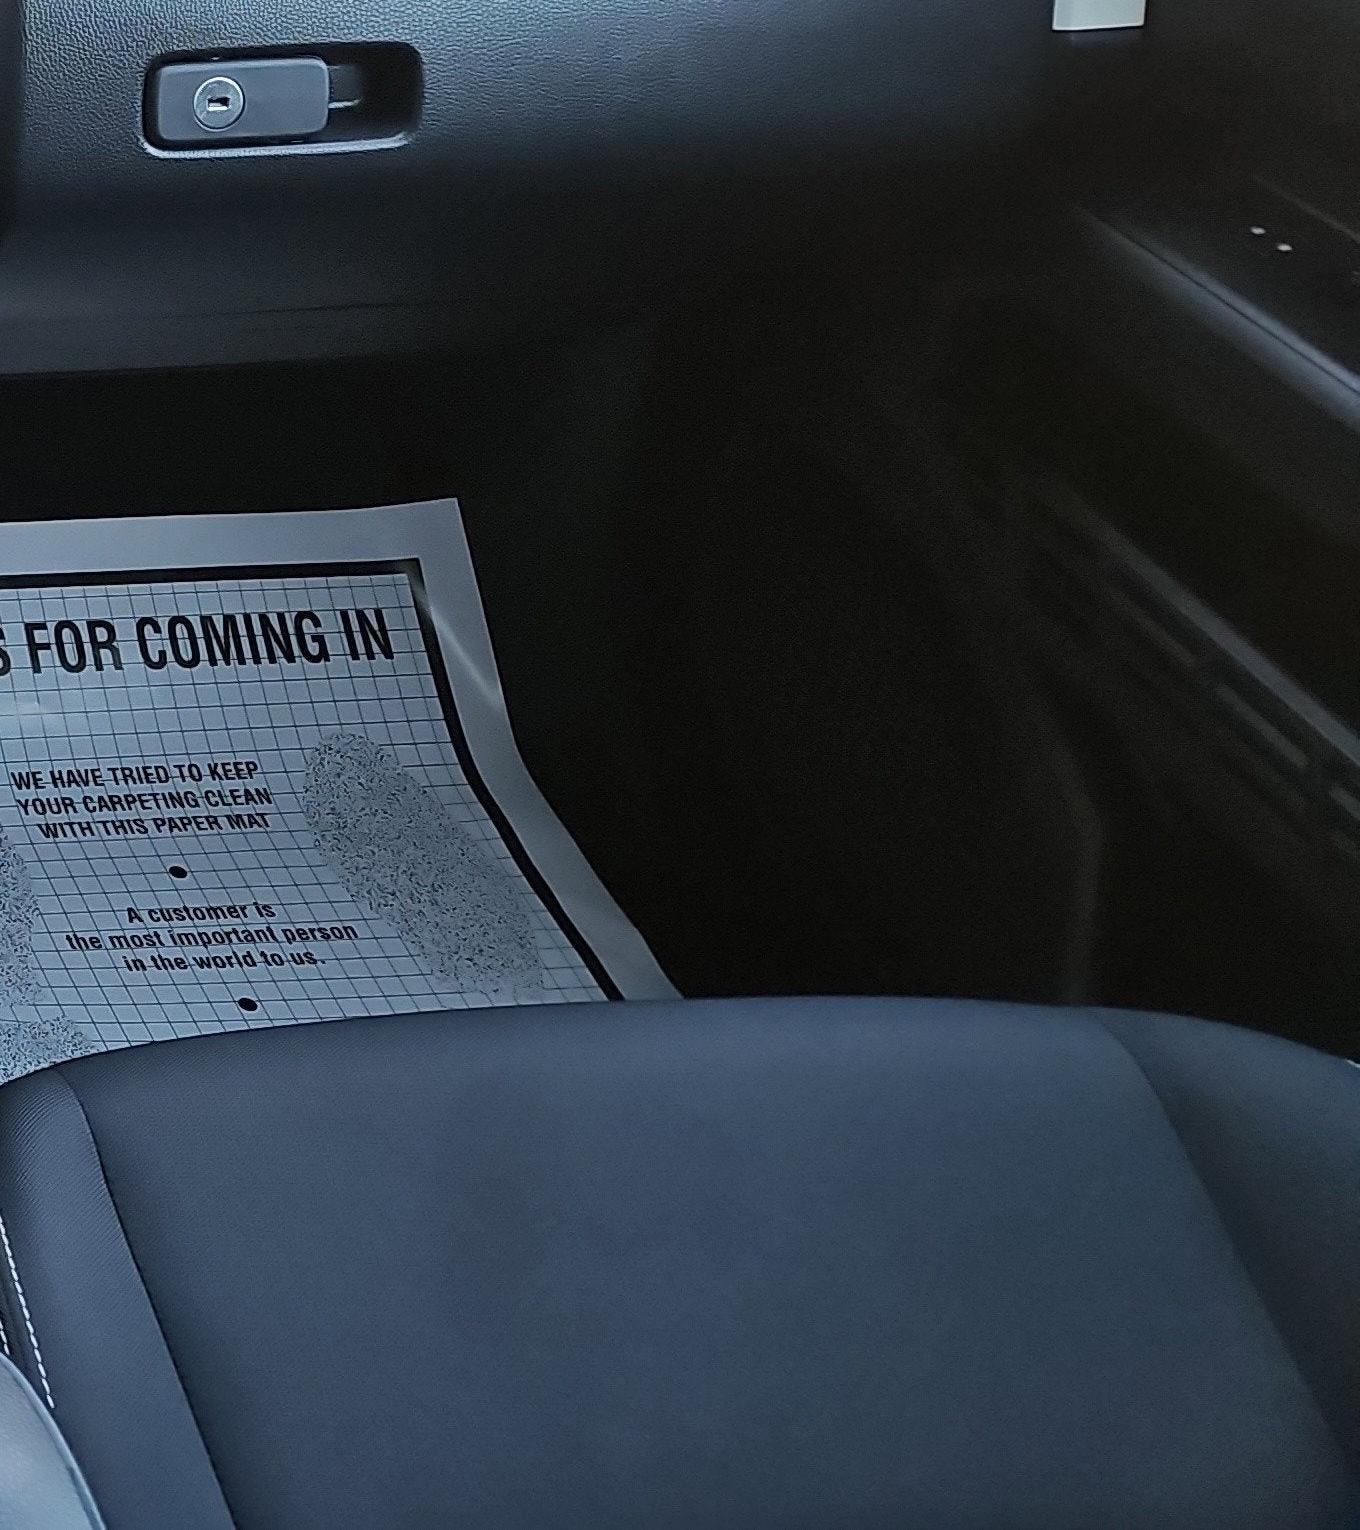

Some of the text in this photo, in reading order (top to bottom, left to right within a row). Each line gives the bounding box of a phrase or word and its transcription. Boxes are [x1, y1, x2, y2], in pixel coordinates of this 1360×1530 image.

[25, 619, 124, 674] FOR
[136, 609, 331, 670] COMING
[338, 608, 396, 662] IN
[10, 760, 259, 791] WE HAVE TRIED TO KEEP
[16, 787, 273, 816] YOUR CARPETING CLEAN
[38, 812, 272, 839] WITH THIS PAPER MAT
[127, 901, 277, 924] A customer is
[65, 923, 359, 951] the most important person
[122, 949, 327, 972] in the world to us.
